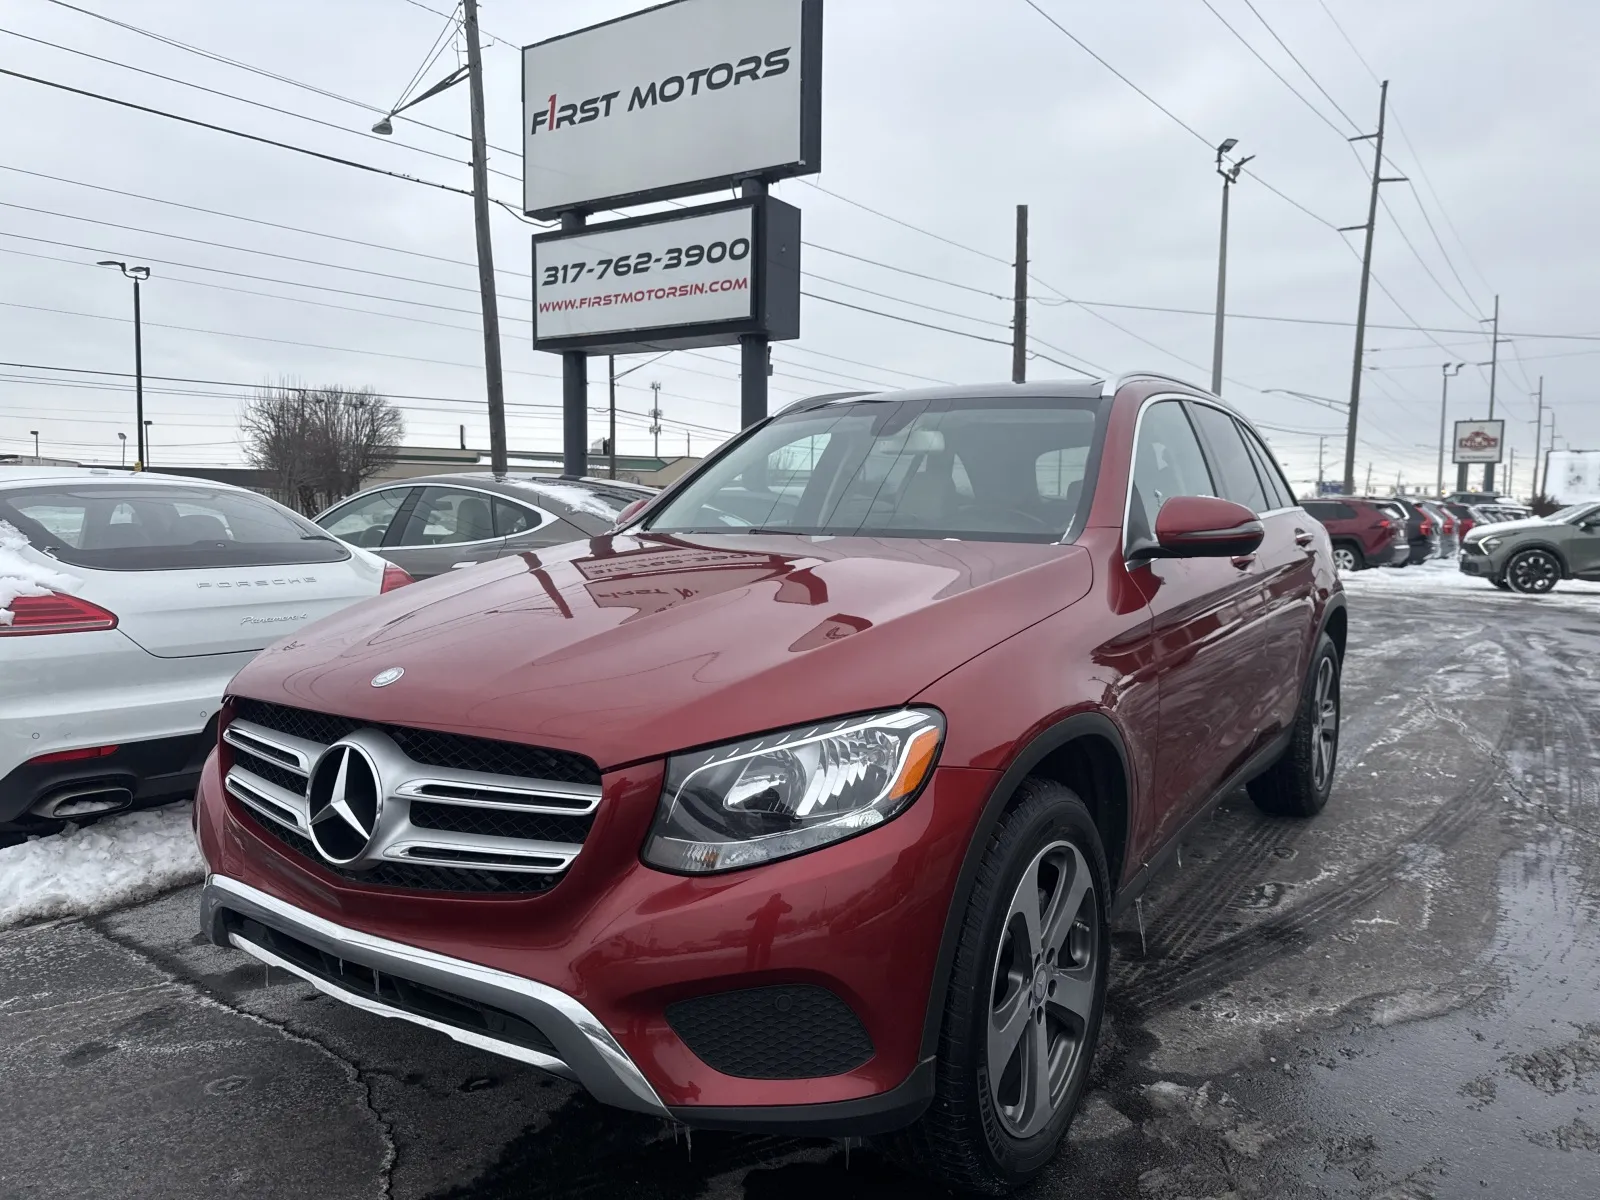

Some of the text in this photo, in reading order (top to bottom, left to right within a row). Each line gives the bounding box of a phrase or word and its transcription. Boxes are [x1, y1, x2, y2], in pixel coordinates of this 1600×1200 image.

[627, 47, 791, 112] MOTORS
[542, 238, 749, 286] 317-762-3900
[539, 277, 747, 313] WWW.FIRSTMOTORSIN.COM
[197, 576, 317, 588] PORSCHE
